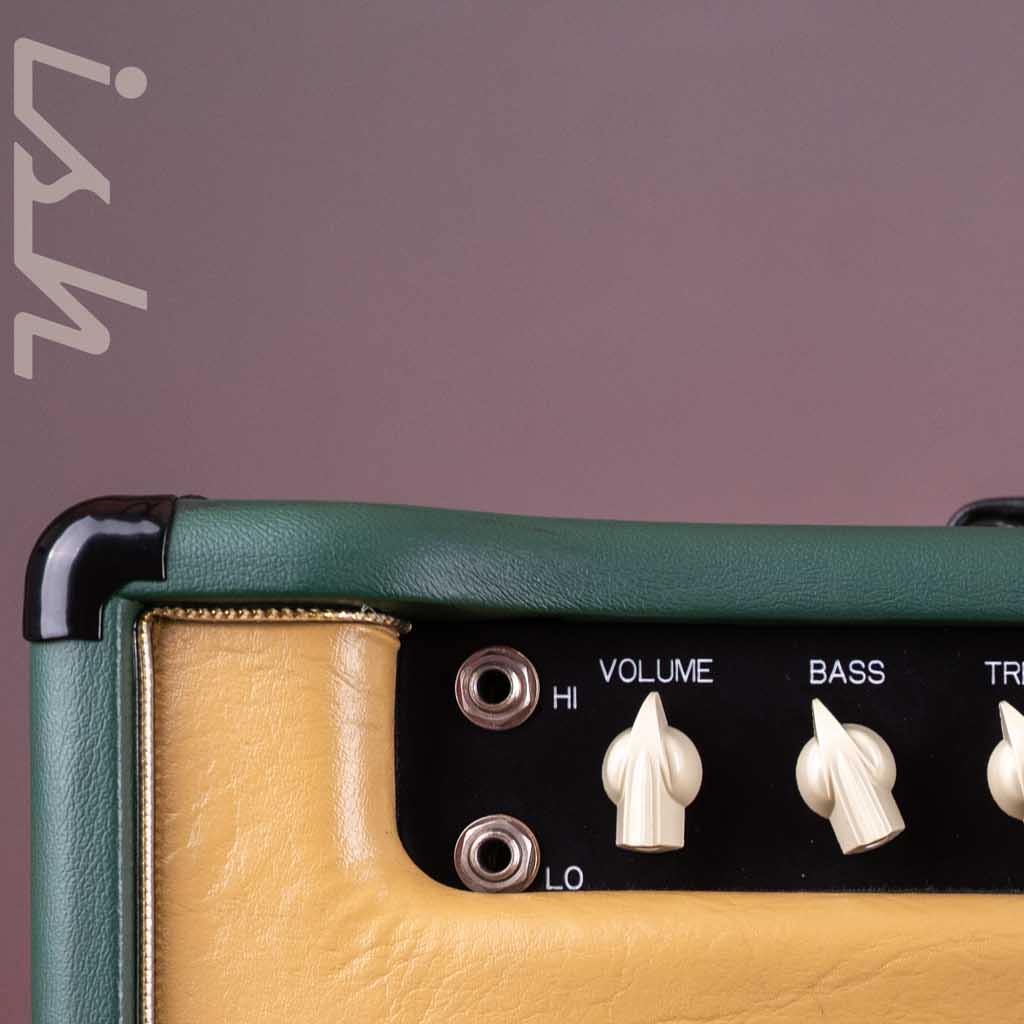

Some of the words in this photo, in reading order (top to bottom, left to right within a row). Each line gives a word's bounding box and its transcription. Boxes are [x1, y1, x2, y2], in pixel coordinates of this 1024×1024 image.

[599, 658, 713, 684] VOLUME
[809, 660, 886, 685] BASS
[553, 687, 578, 710] HI
[545, 866, 584, 891] LO
